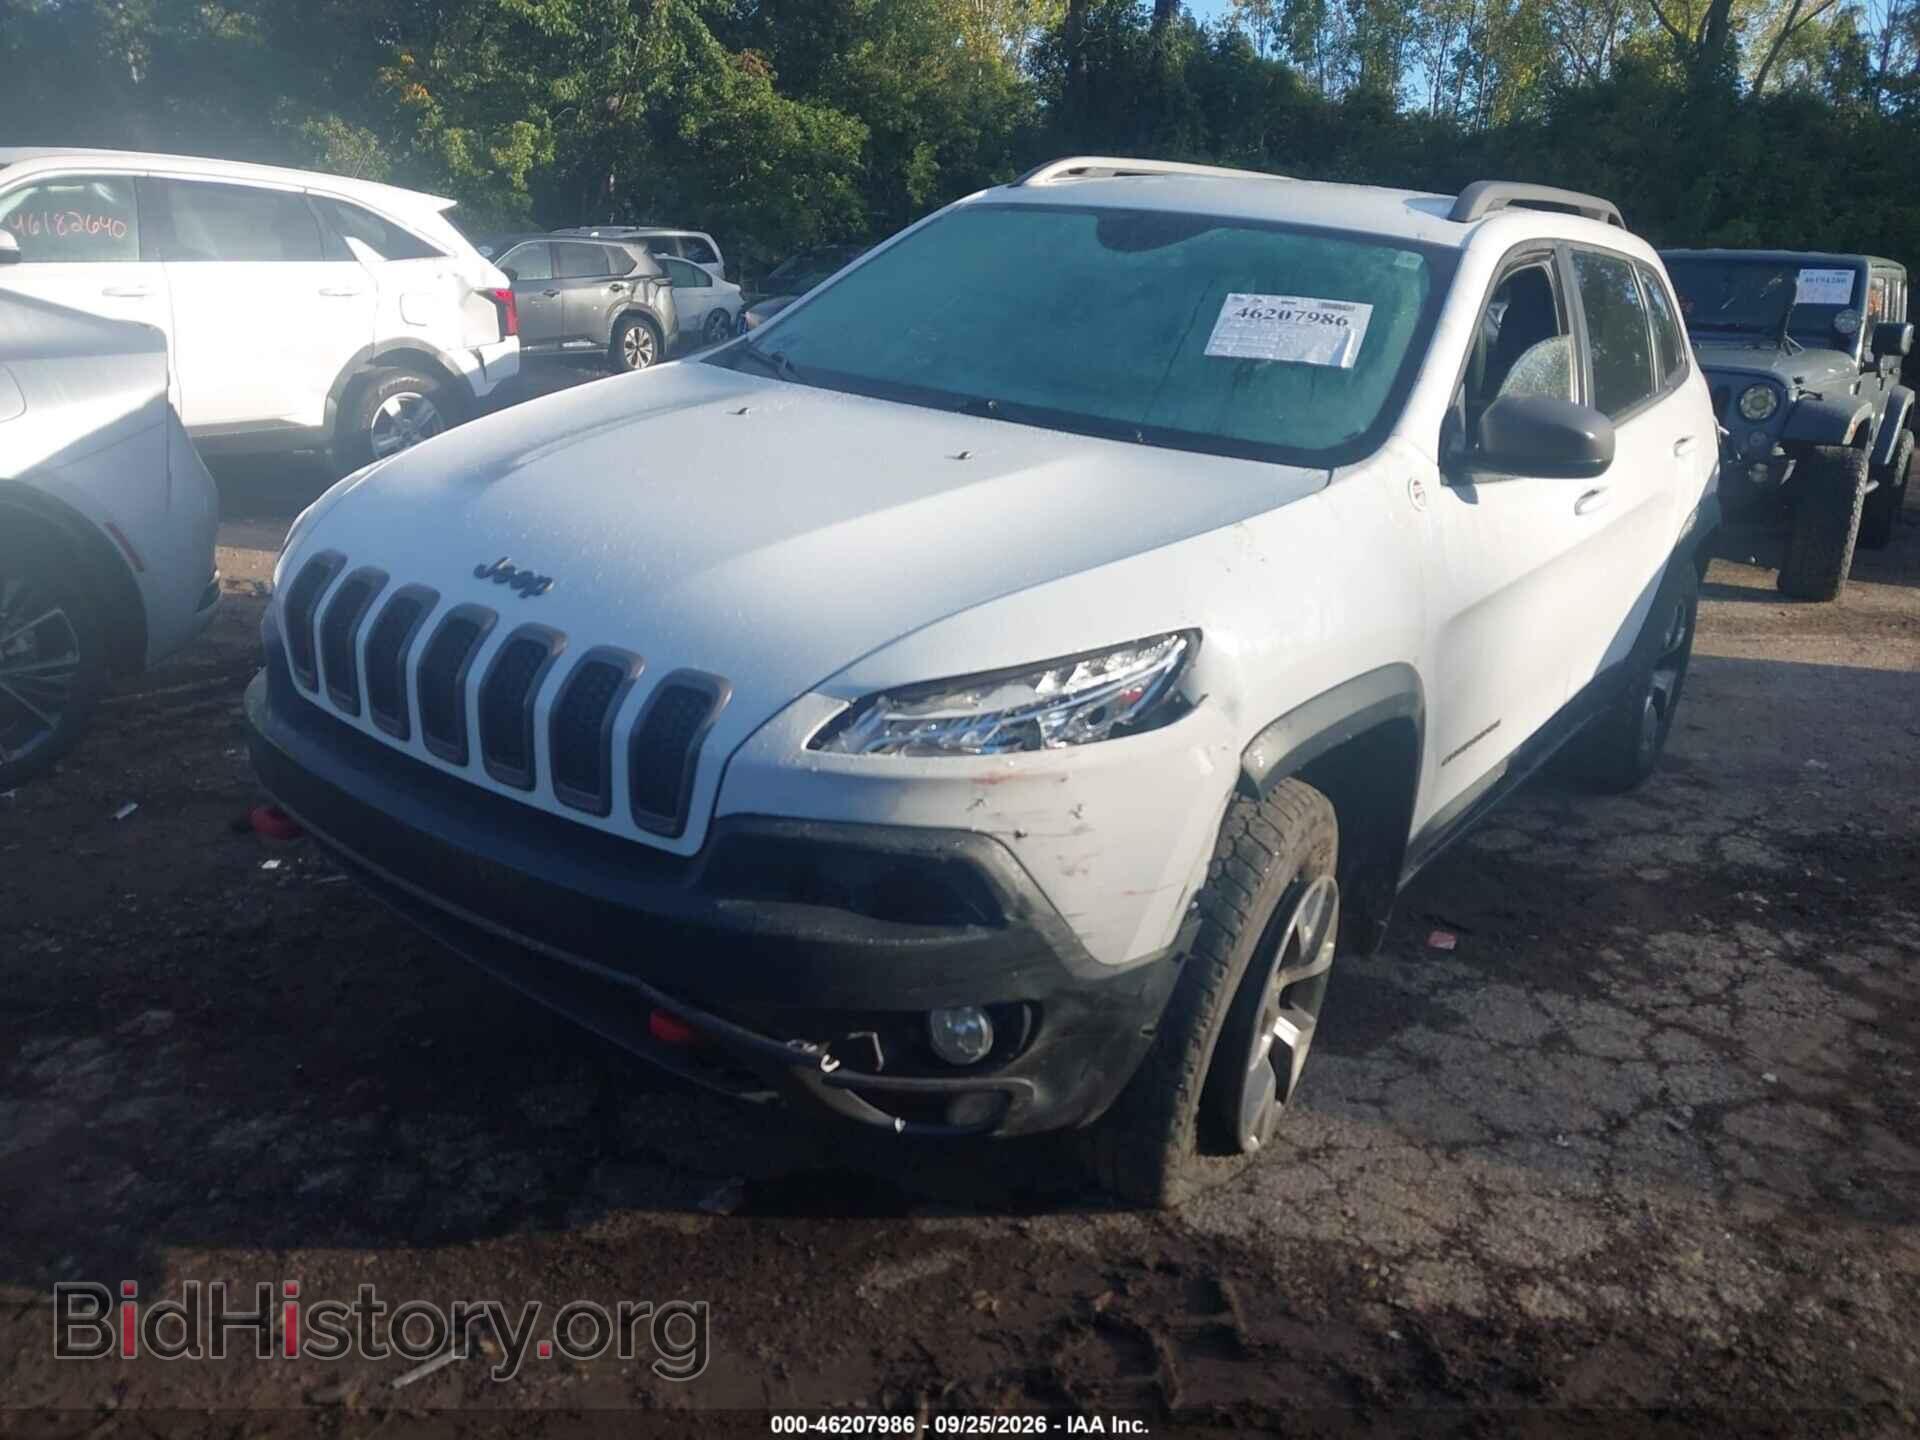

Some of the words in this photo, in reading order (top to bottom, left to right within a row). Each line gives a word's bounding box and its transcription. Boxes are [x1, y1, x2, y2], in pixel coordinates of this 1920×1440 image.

[9, 210, 128, 238] 46182640
[1234, 306, 1349, 328] 46207986
[473, 556, 554, 599] Jeep
